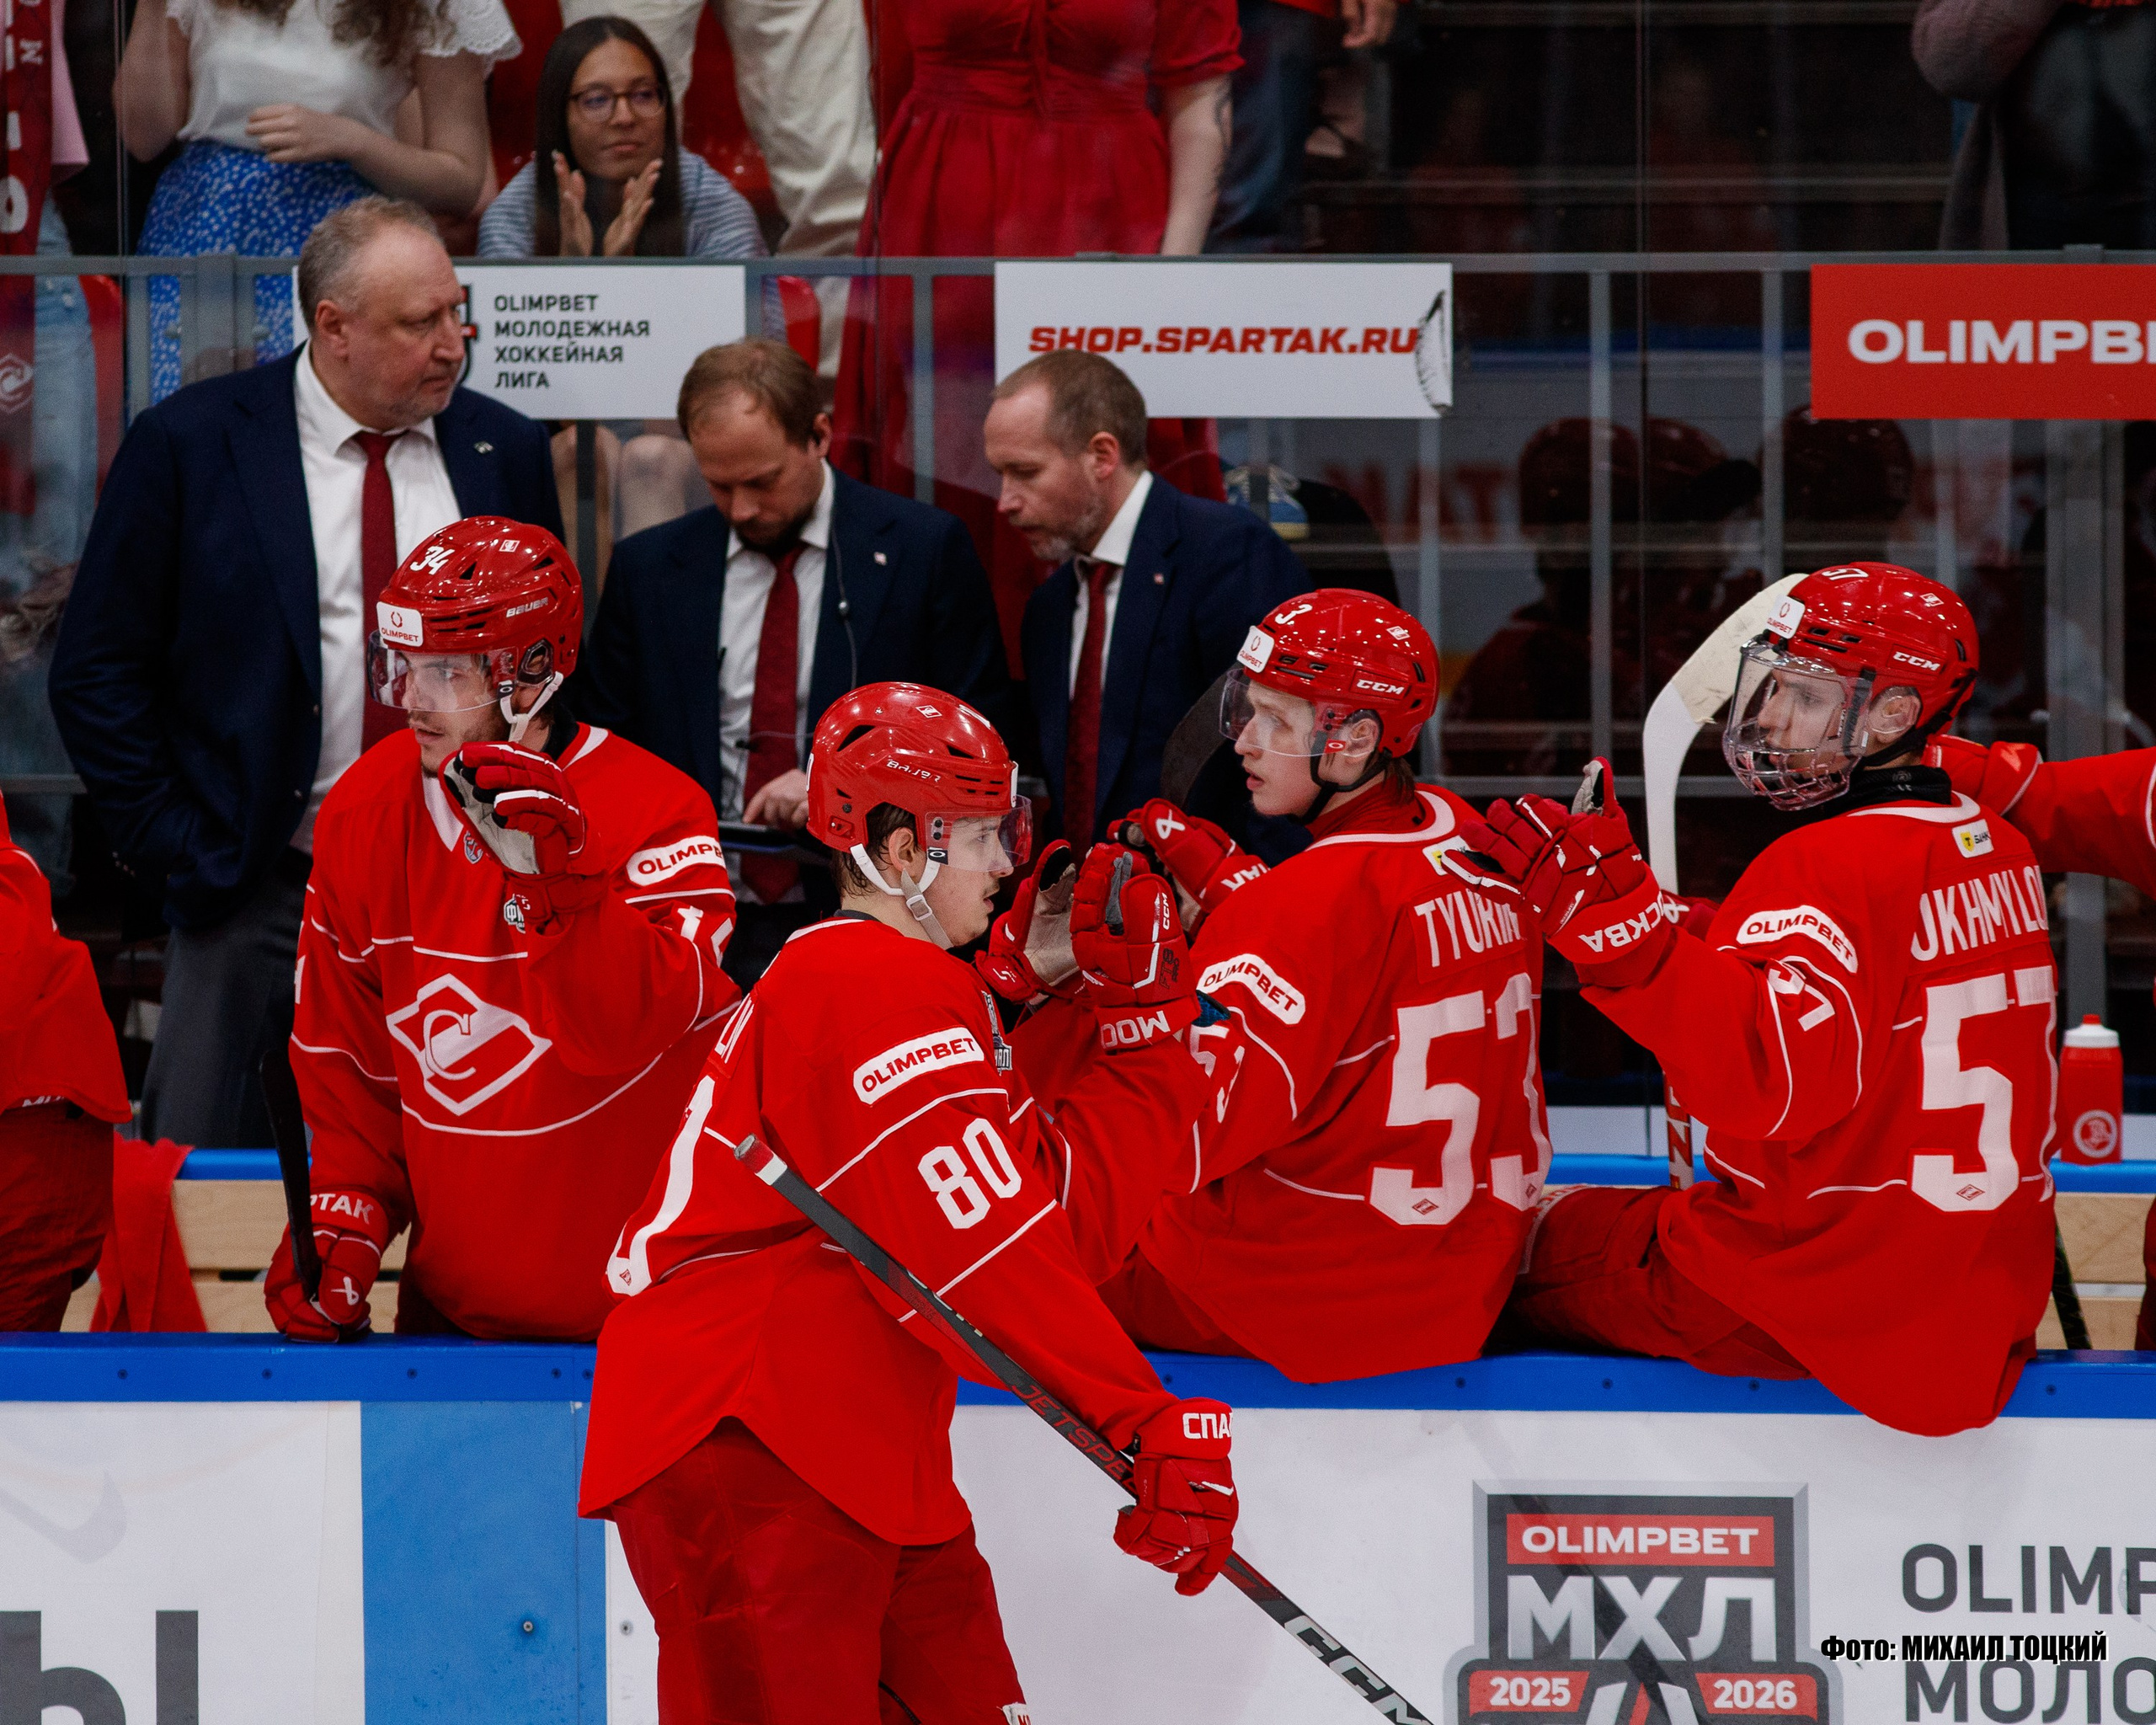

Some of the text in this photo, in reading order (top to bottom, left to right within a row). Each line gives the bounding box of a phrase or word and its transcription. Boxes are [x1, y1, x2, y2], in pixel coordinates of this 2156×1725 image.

[494, 295, 598, 311] OLIMPBET
[494, 320, 650, 339] МОЛОДЕЖНАЯ
[1028, 327, 1422, 354] SHOP.SPARTAK.RU
[1848, 318, 2156, 365] OLIMPB
[494, 341, 623, 363] ХОККЕЙНАЯ
[494, 371, 550, 388] ЛИГА
[409, 546, 455, 575] 34
[506, 597, 549, 618] BAUER
[381, 627, 419, 643] OLIMPBET
[1893, 651, 1940, 671] CCM
[1356, 679, 1405, 696] CCM
[1162, 893, 1171, 930] CCM
[1414, 887, 1521, 968] TYURIN
[1747, 915, 1853, 960] OLIMPBET
[1203, 962, 1299, 1012] OLIMPBET
[862, 1038, 974, 1092] OLIMPBET
[917, 1118, 1022, 1230] 80
[1522, 1526, 1759, 1555] OLIMPBET
[1507, 1575, 1778, 1663] МХЛ
[1489, 1678, 1797, 1710] 2025 2026
